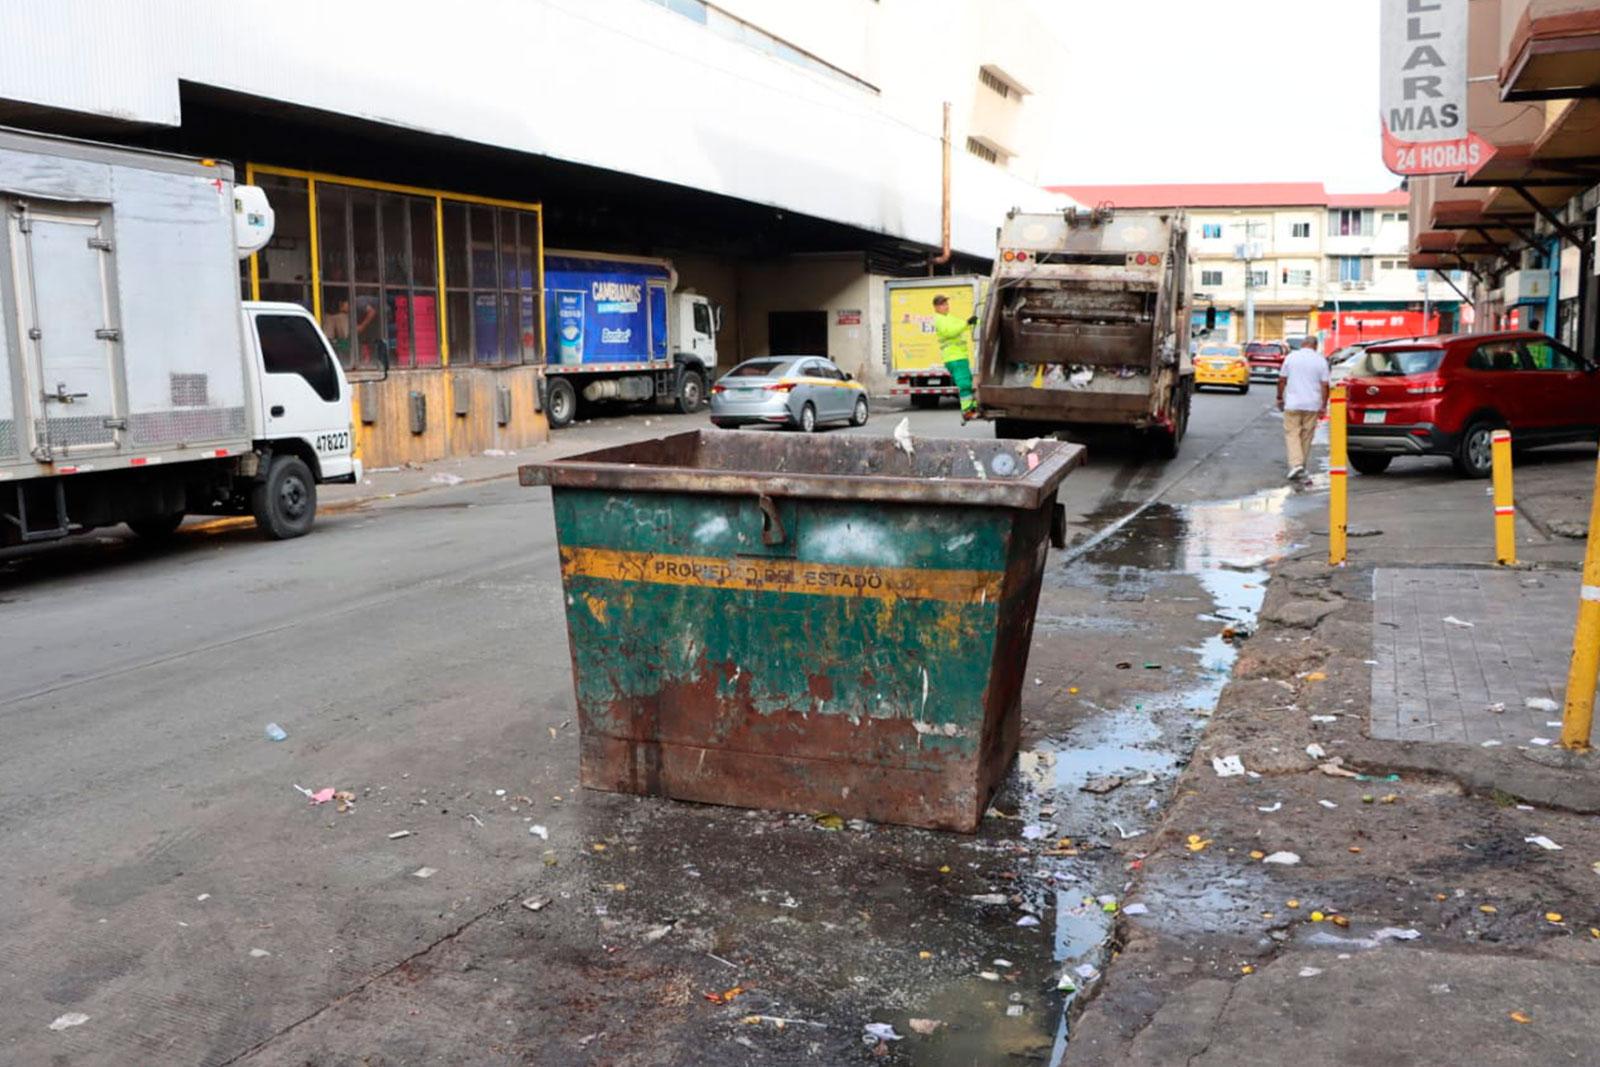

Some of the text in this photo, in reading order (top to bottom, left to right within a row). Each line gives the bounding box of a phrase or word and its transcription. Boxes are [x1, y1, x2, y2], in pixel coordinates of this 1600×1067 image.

[1389, 104, 1459, 132] MAS
[1396, 144, 1480, 170] 24 HORAS
[316, 432, 348, 451] 478227
[655, 561, 757, 583] PROPIEDD
[804, 571, 882, 589] ESTADO
